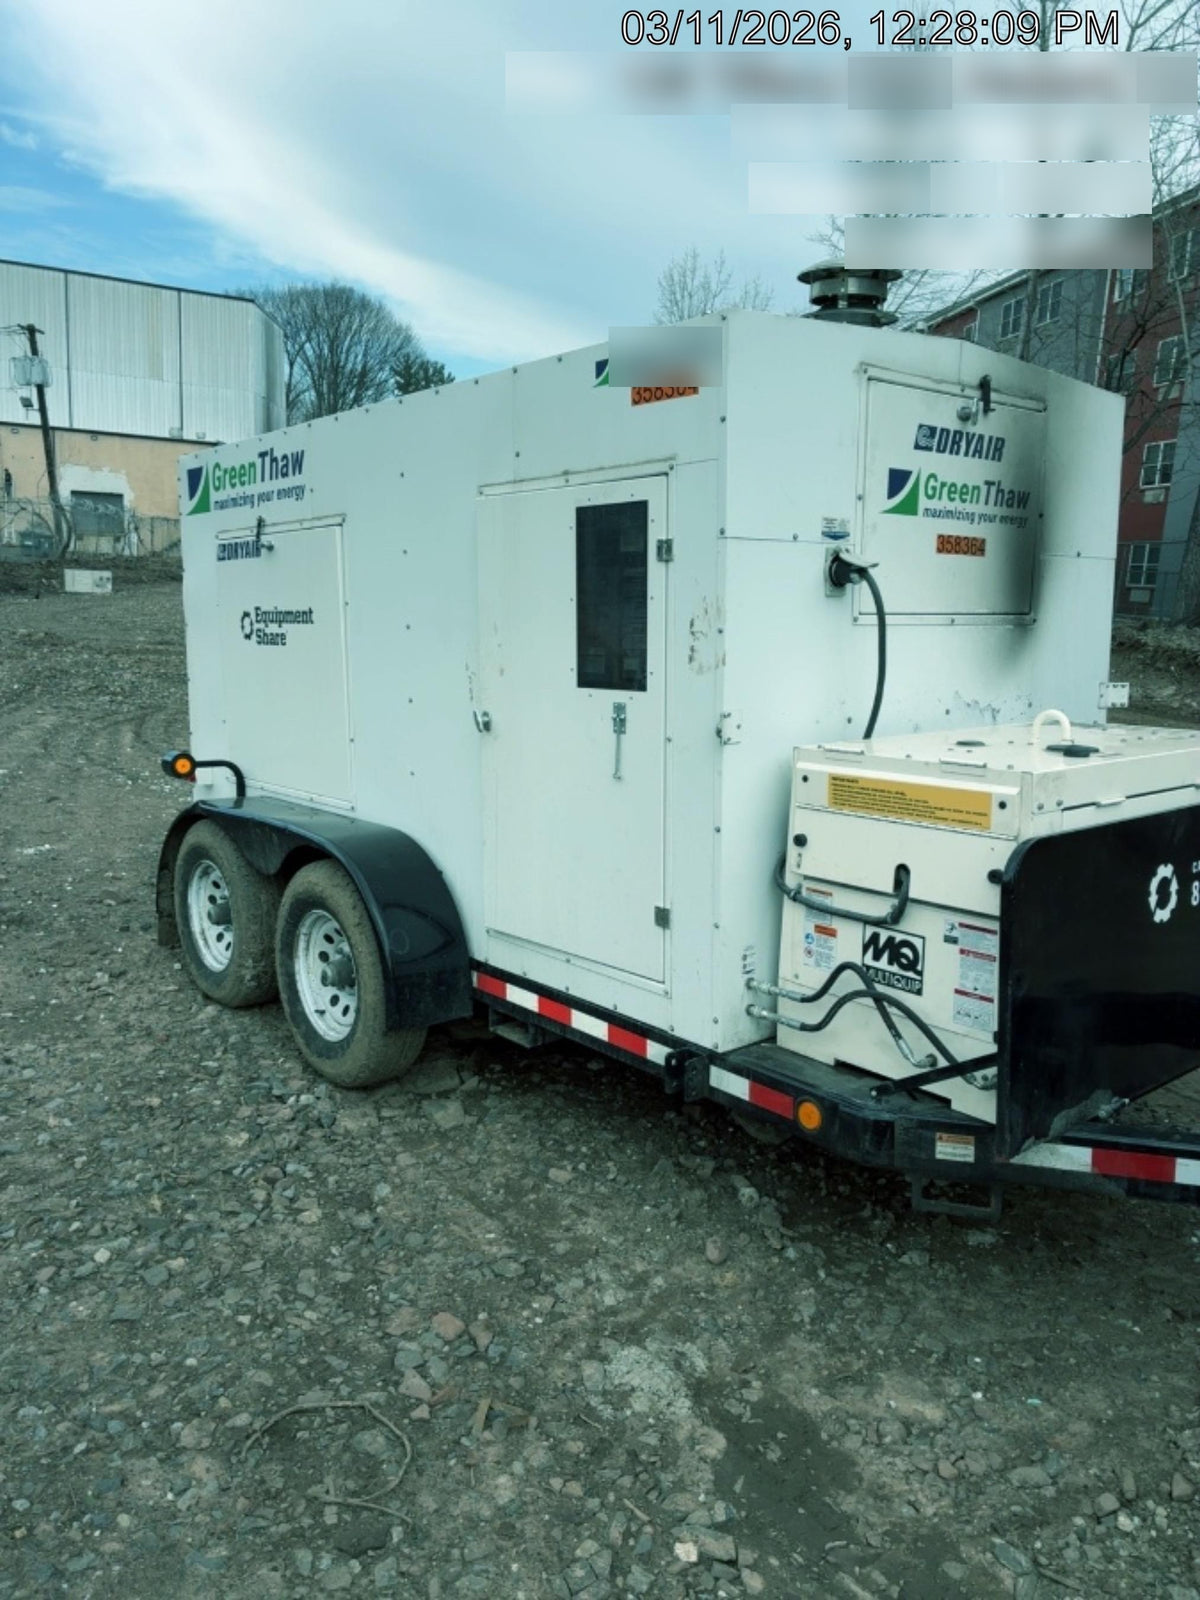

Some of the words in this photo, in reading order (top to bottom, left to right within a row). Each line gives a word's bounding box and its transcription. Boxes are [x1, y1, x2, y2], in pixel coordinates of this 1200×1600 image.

[935, 427, 1006, 463] DRYAIR
[213, 491, 255, 511] maximizing
[257, 489, 274, 508] your
[276, 484, 306, 502] energy
[922, 506, 976, 525] maximizing
[977, 511, 999, 525] your
[999, 515, 1029, 529] energy
[936, 534, 986, 557] 358364
[254, 606, 314, 628] Equipment
[255, 628, 287, 646] Share
[863, 931, 923, 977] MQ
